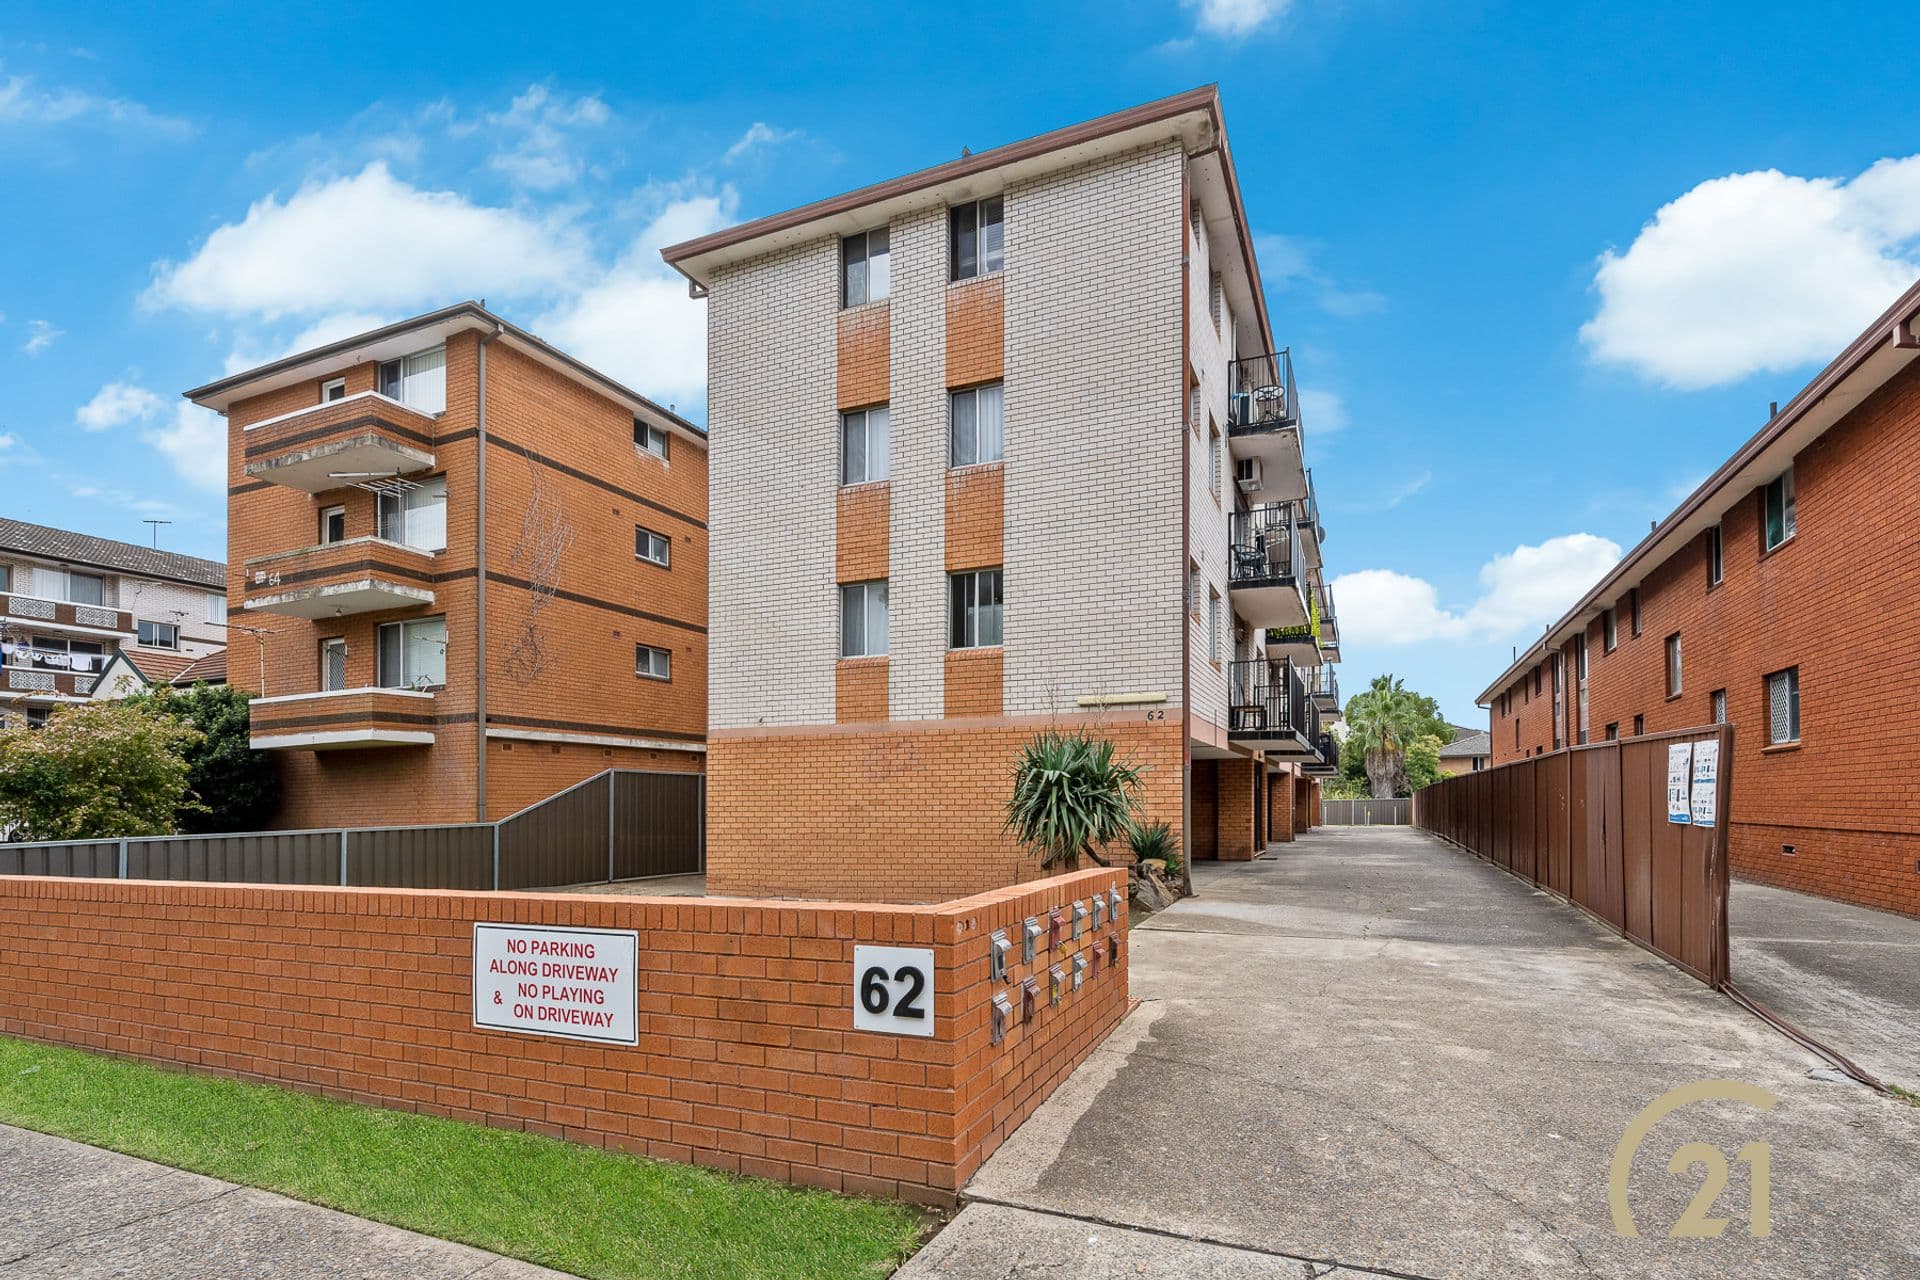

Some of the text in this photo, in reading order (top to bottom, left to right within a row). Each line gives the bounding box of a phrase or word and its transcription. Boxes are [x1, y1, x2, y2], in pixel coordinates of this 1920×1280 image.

[268, 569, 281, 586] 64
[1147, 710, 1164, 720] 62
[507, 939, 595, 959] NO PARKING
[489, 959, 618, 983] ALONG DRIVEWAY
[493, 990, 503, 1005] &
[518, 982, 605, 1005] NO PLAYING
[861, 966, 925, 1019] 62
[513, 1003, 614, 1028] ON DRIVEWAY
